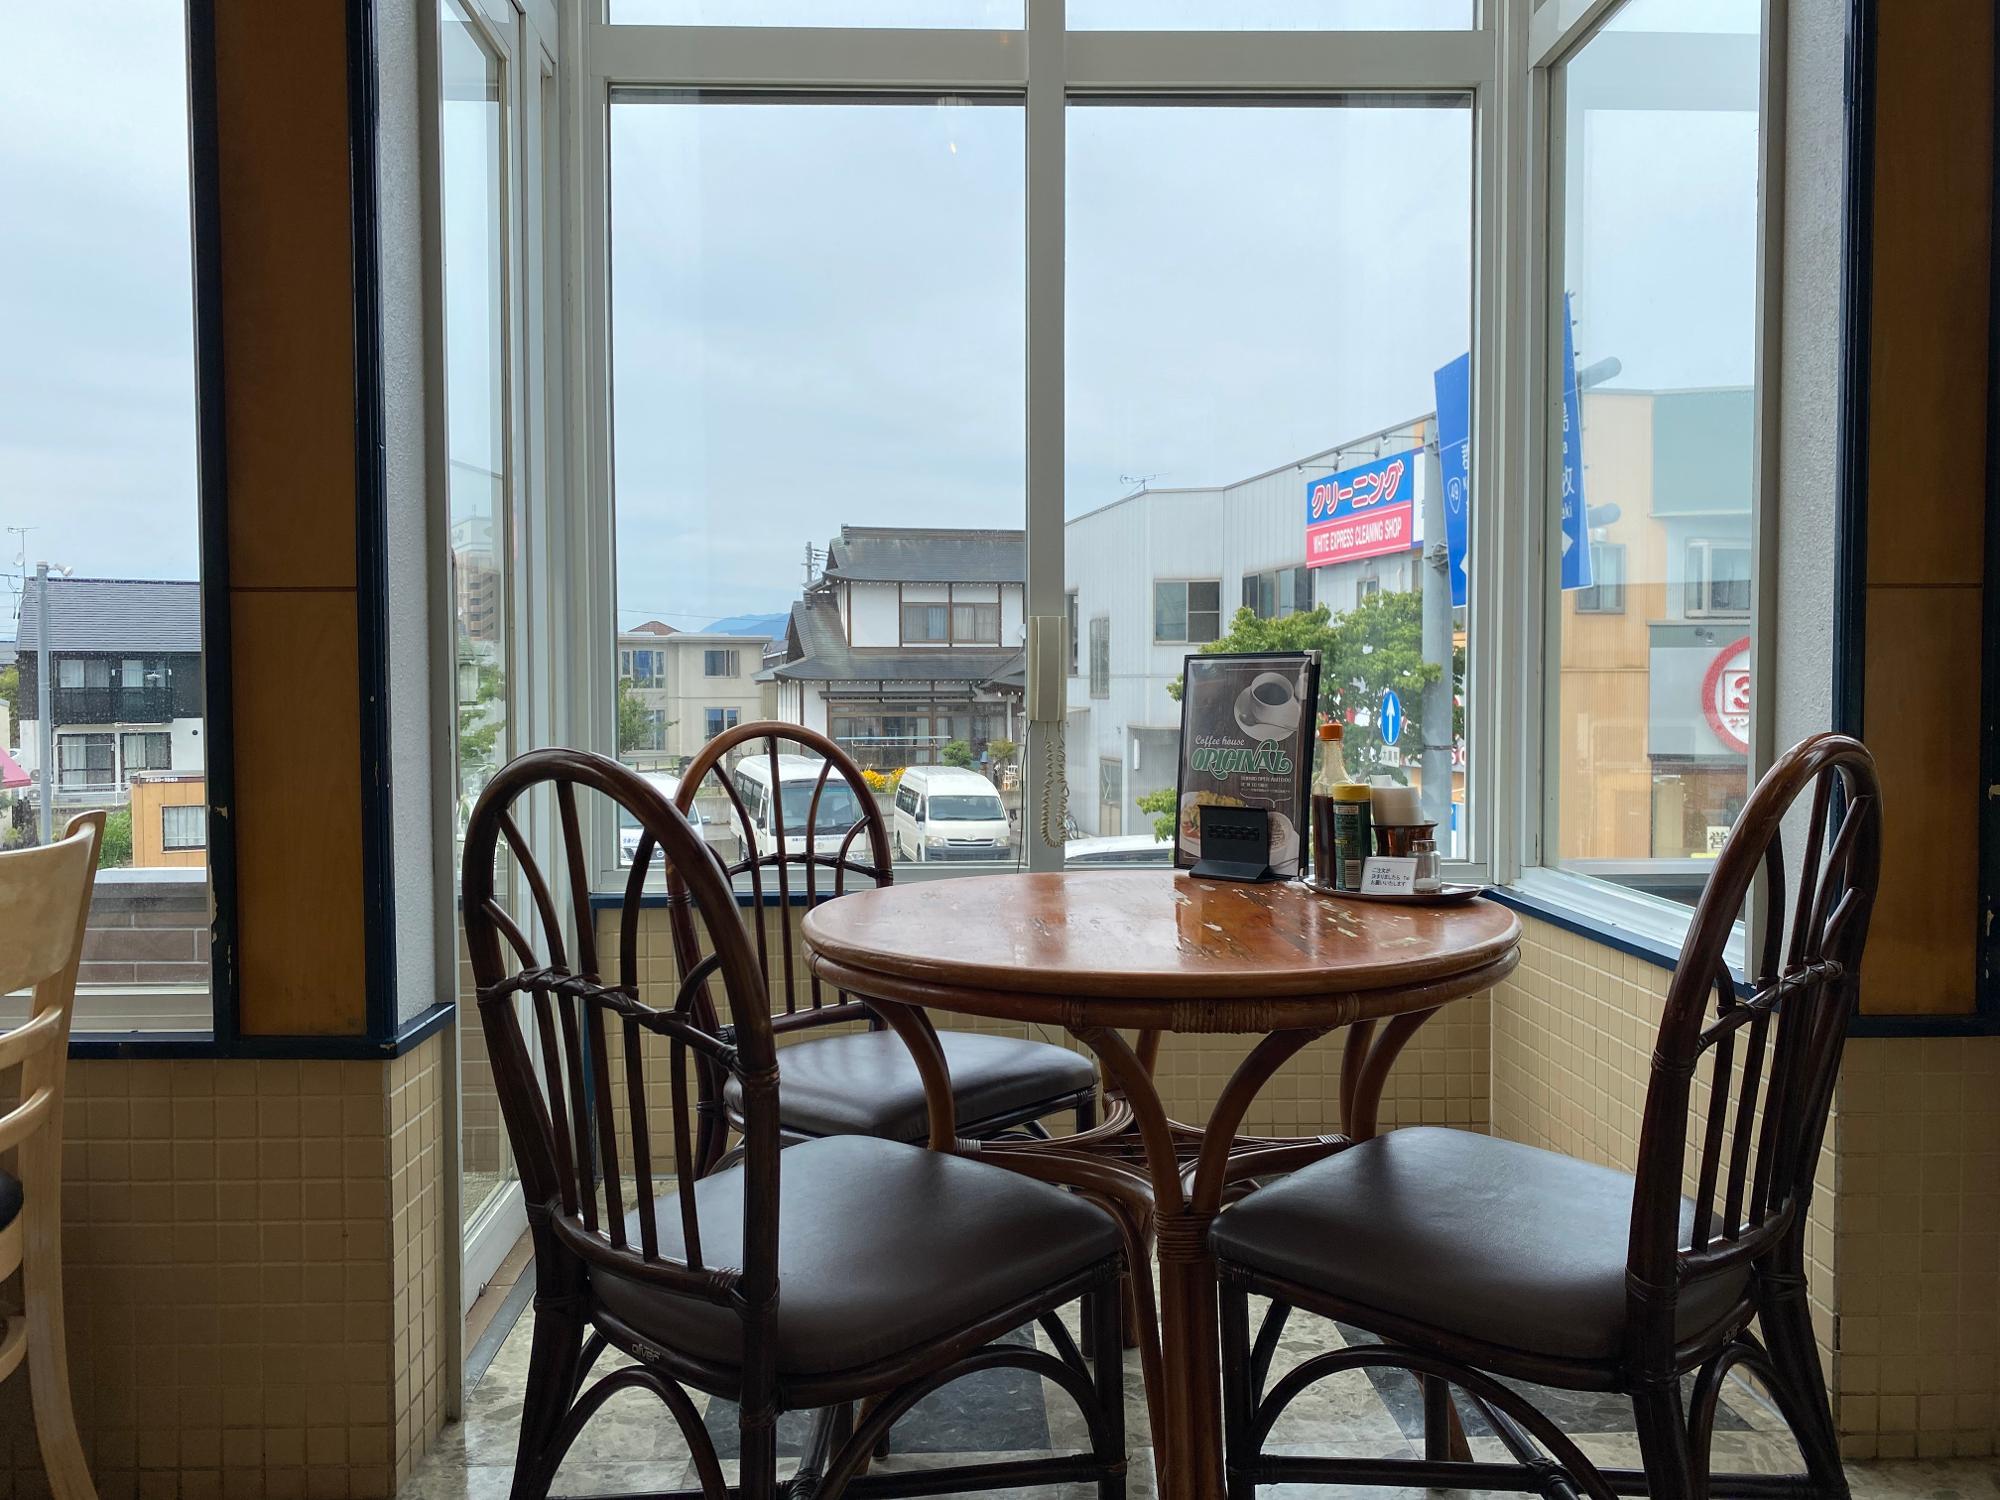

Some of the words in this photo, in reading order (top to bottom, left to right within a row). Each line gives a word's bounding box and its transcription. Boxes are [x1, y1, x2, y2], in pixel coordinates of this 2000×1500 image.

[1312, 459, 1404, 518] クリーニング
[1313, 533, 1330, 554] WHITE
[1330, 528, 1354, 551] EXPRESS
[1355, 521, 1383, 545] CLEANING
[1384, 517, 1401, 540] SHOP
[1191, 738, 1293, 780] ORIGINAL
[1195, 734, 1220, 747] Coffee
[1221, 735, 1245, 746] house
